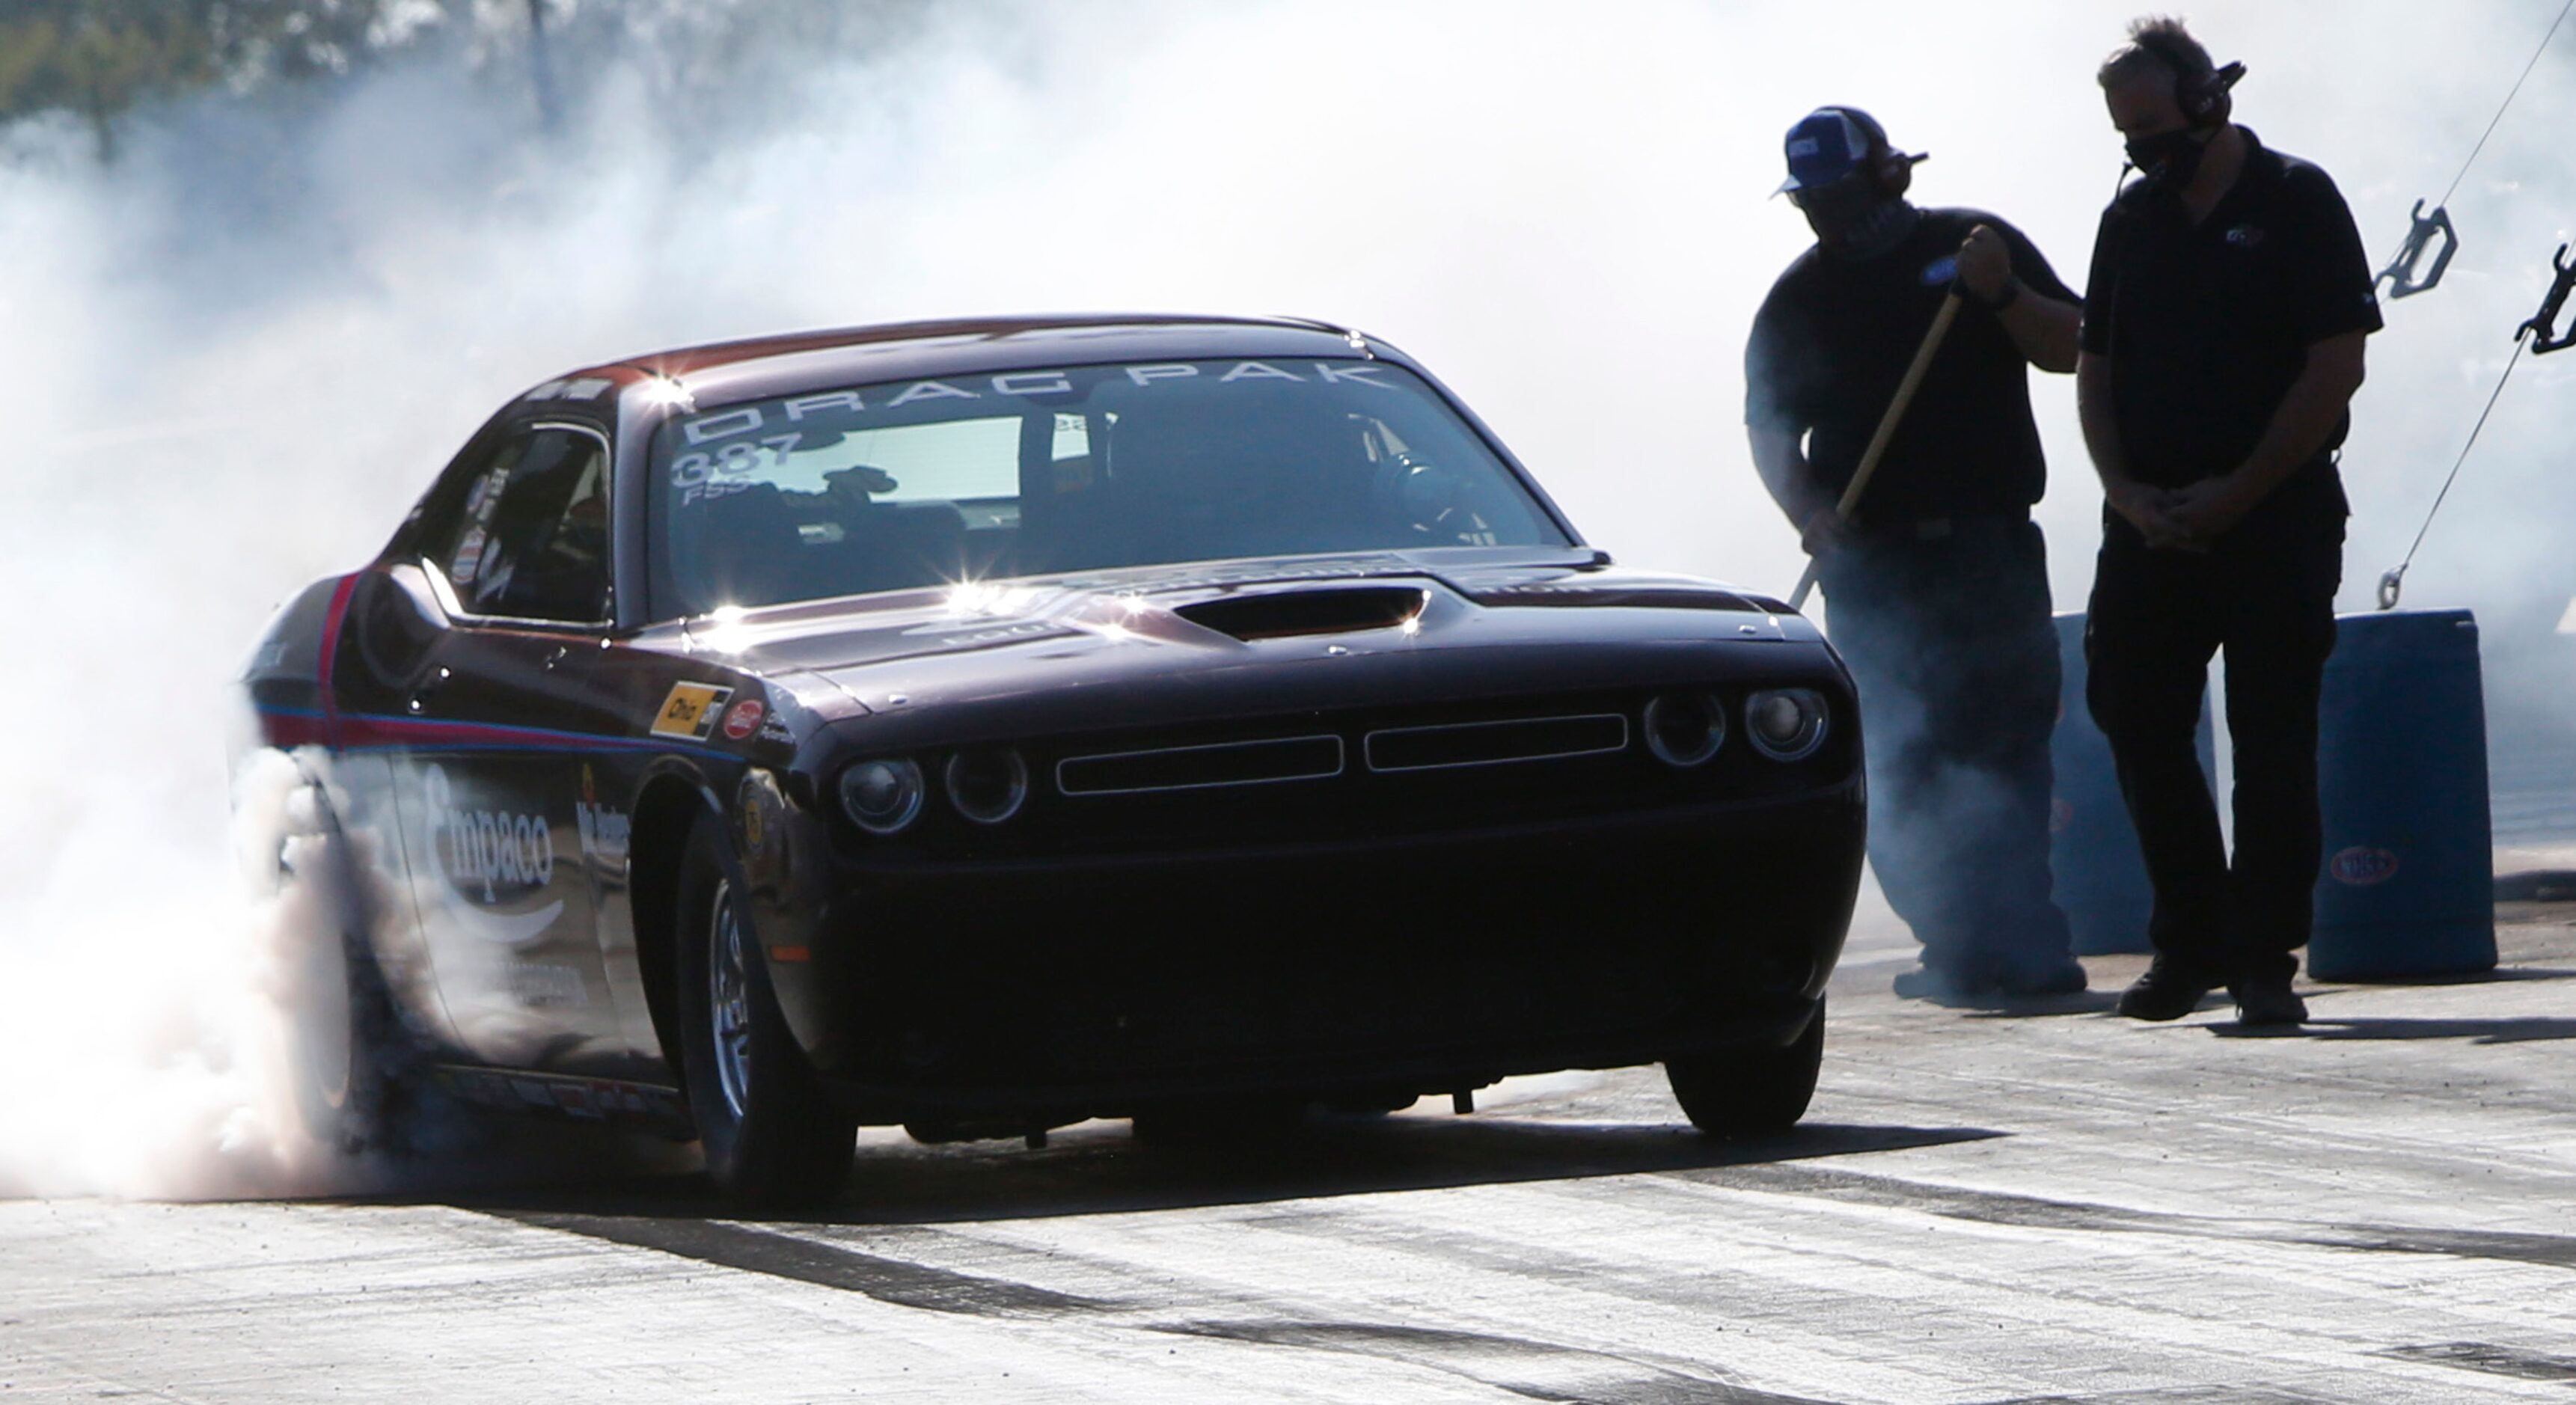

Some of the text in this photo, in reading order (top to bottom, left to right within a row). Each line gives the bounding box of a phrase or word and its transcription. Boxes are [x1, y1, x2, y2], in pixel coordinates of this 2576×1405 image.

[684, 361, 1400, 446] DRAG PAK
[673, 432, 804, 489] 387
